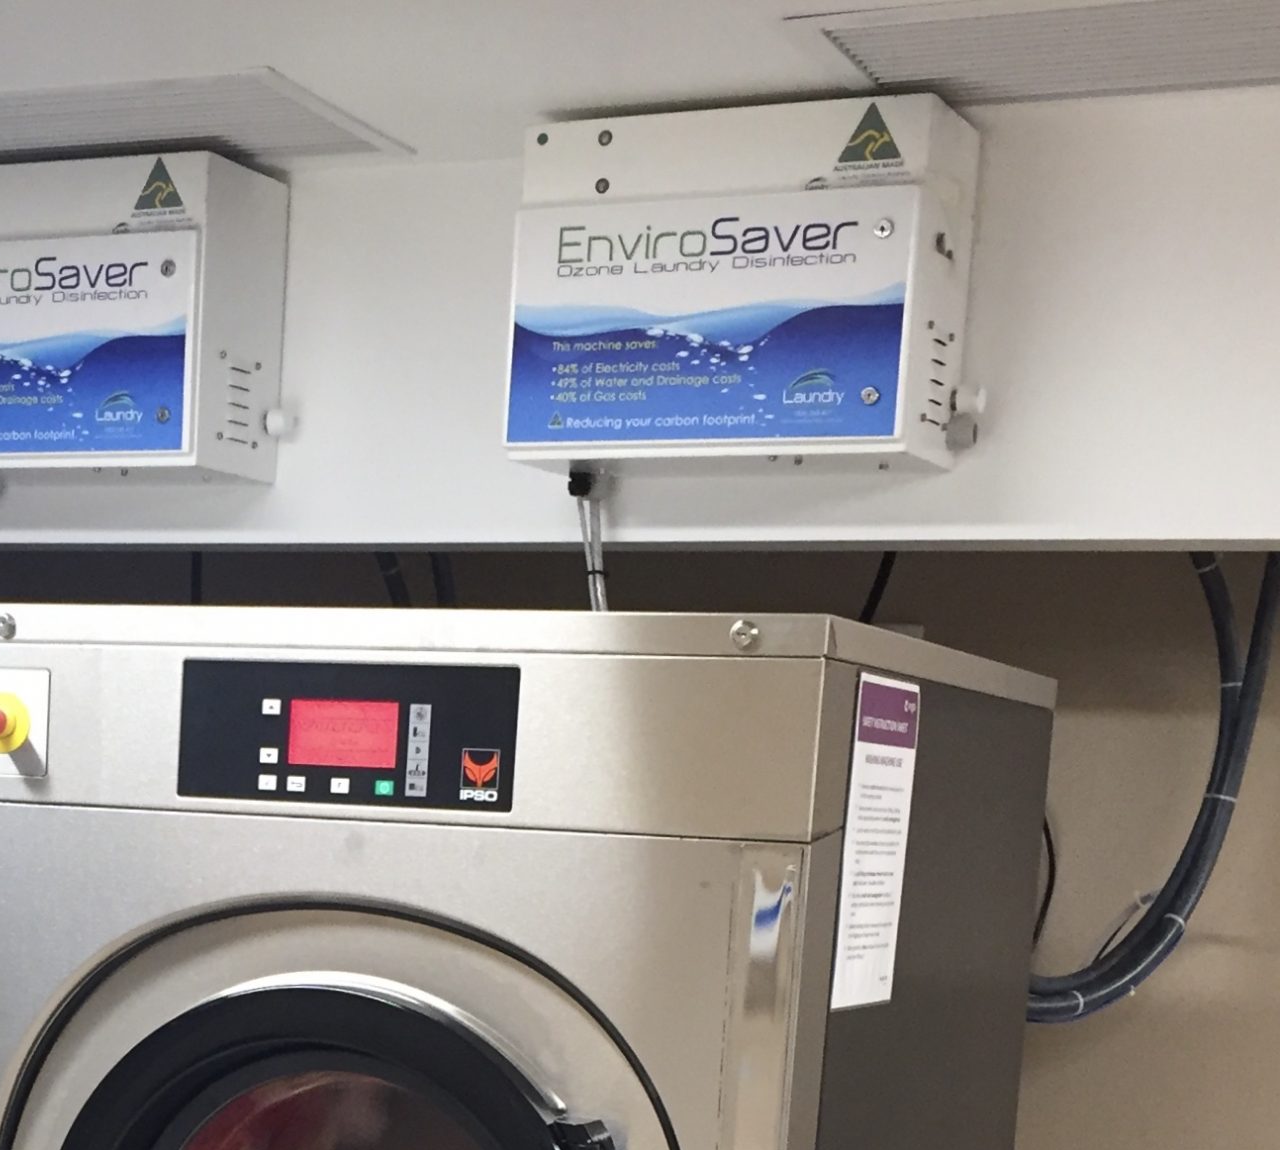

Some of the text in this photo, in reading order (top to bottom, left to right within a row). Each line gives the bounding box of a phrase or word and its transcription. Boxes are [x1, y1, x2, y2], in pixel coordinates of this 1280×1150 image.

[558, 216, 859, 264] EnviroSaver
[557, 252, 857, 278] Ozone Laundry Disinfection
[52, 289, 148, 302] Disinfection
[553, 341, 570, 352] This
[573, 340, 622, 352] machine
[581, 363, 593, 374] of
[595, 362, 649, 374] Electricity
[651, 361, 680, 372] costs
[579, 377, 592, 388] of
[595, 376, 628, 387] Water
[631, 375, 654, 386] and
[656, 374, 710, 388] Drainage
[712, 373, 742, 385] costs
[579, 391, 592, 402] of
[594, 391, 616, 401] Gas
[618, 390, 647, 401] costs
[782, 388, 845, 405] Laundry
[95, 408, 144, 423] Laundry
[566, 416, 623, 430] Reducing
[625, 417, 651, 429] your
[655, 415, 699, 427] carbon
[459, 789, 498, 802] IPSO
